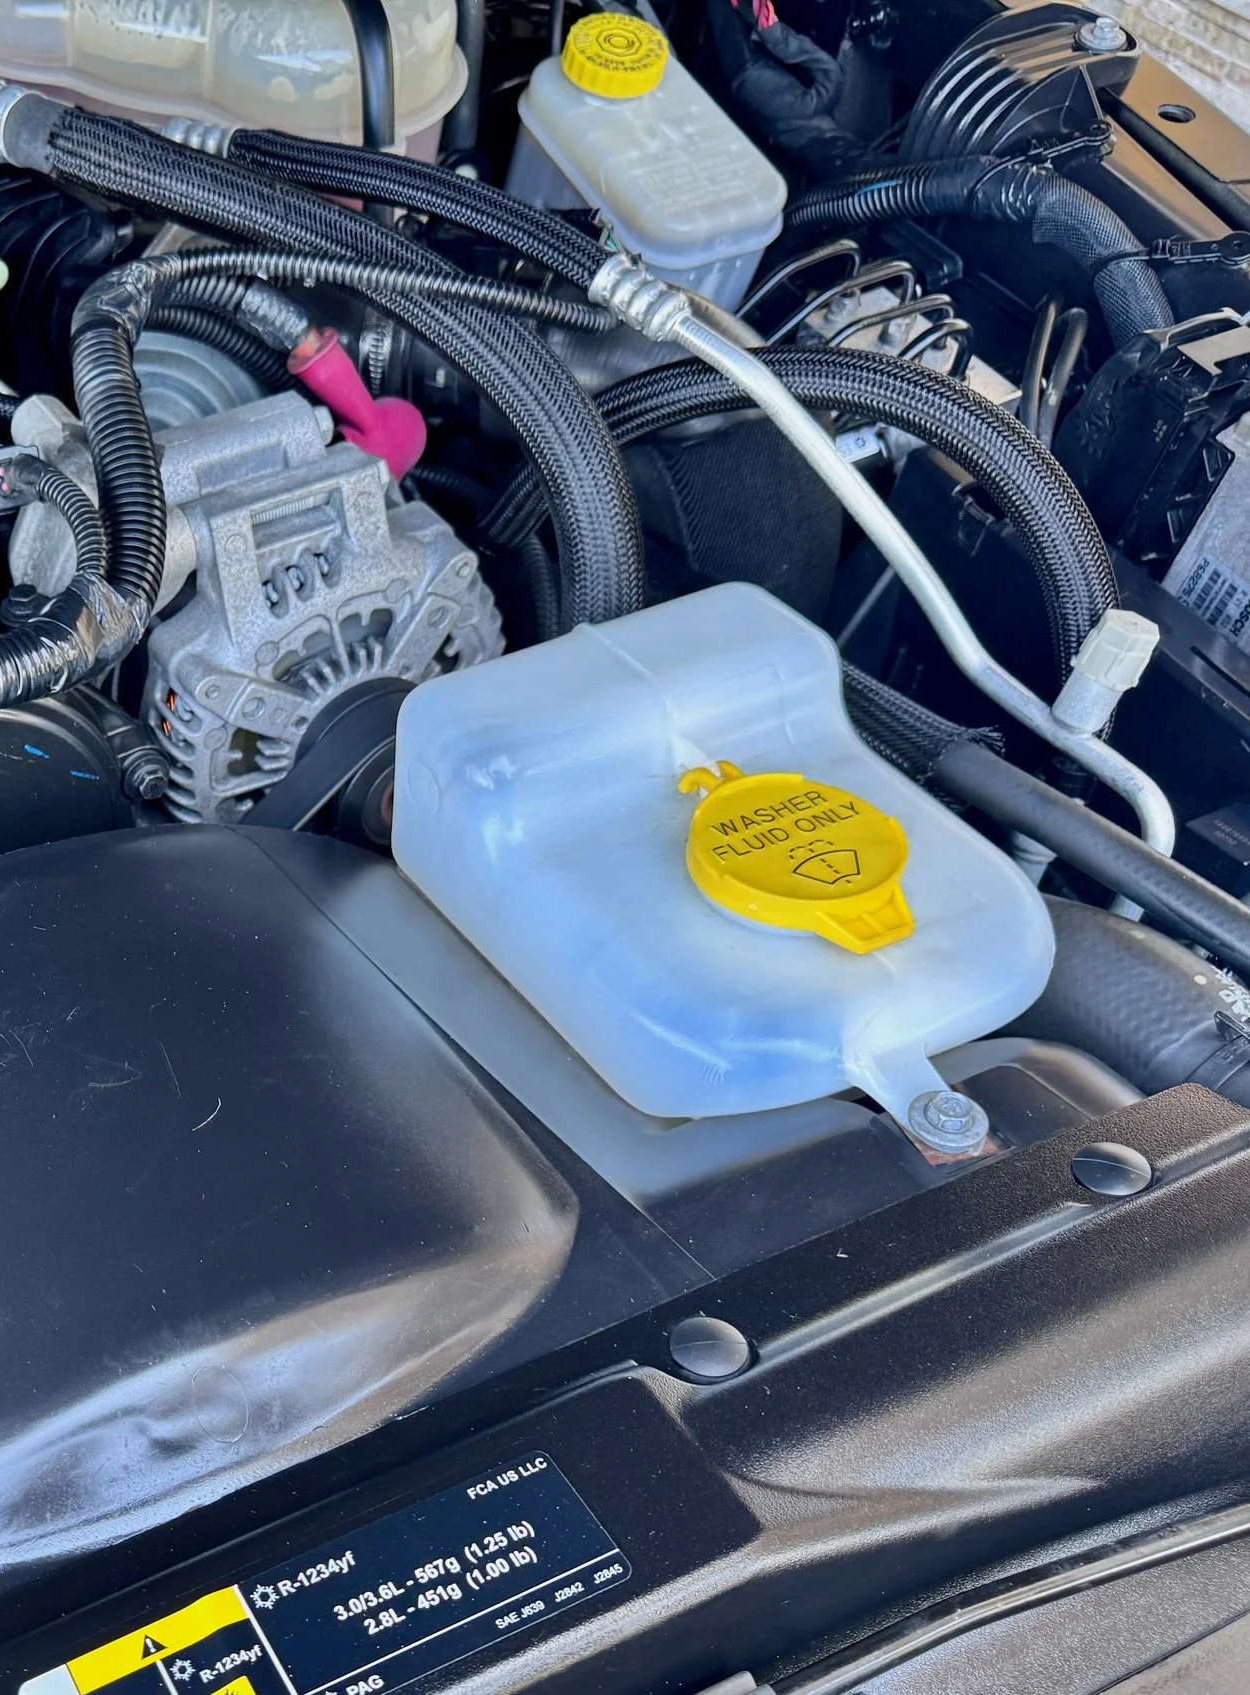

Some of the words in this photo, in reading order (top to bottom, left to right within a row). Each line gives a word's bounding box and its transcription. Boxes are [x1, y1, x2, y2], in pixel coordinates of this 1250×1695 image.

[710, 790, 829, 837] WASHER
[711, 826, 790, 864] FLUID
[793, 800, 863, 833] ONLY
[466, 1479, 498, 1500] FCA
[497, 1469, 520, 1488] US
[518, 1457, 548, 1479] LLC
[277, 1550, 357, 1597] R-1234yf
[332, 1579, 405, 1622] 3.0/3.6L
[414, 1557, 461, 1585] 567g
[463, 1531, 509, 1564] (1.25
[506, 1520, 536, 1547] lb)
[363, 1606, 407, 1636] 2.8L
[416, 1584, 463, 1613] 451g
[465, 1557, 511, 1592] (1.00
[507, 1545, 538, 1572] lb)
[494, 1611, 521, 1631] SAE
[519, 1599, 546, 1620] J639
[553, 1581, 586, 1604] J2842
[593, 1563, 625, 1585] J2845
[199, 1644, 264, 1684] R-1234yf
[346, 1674, 385, 1695] PAG
